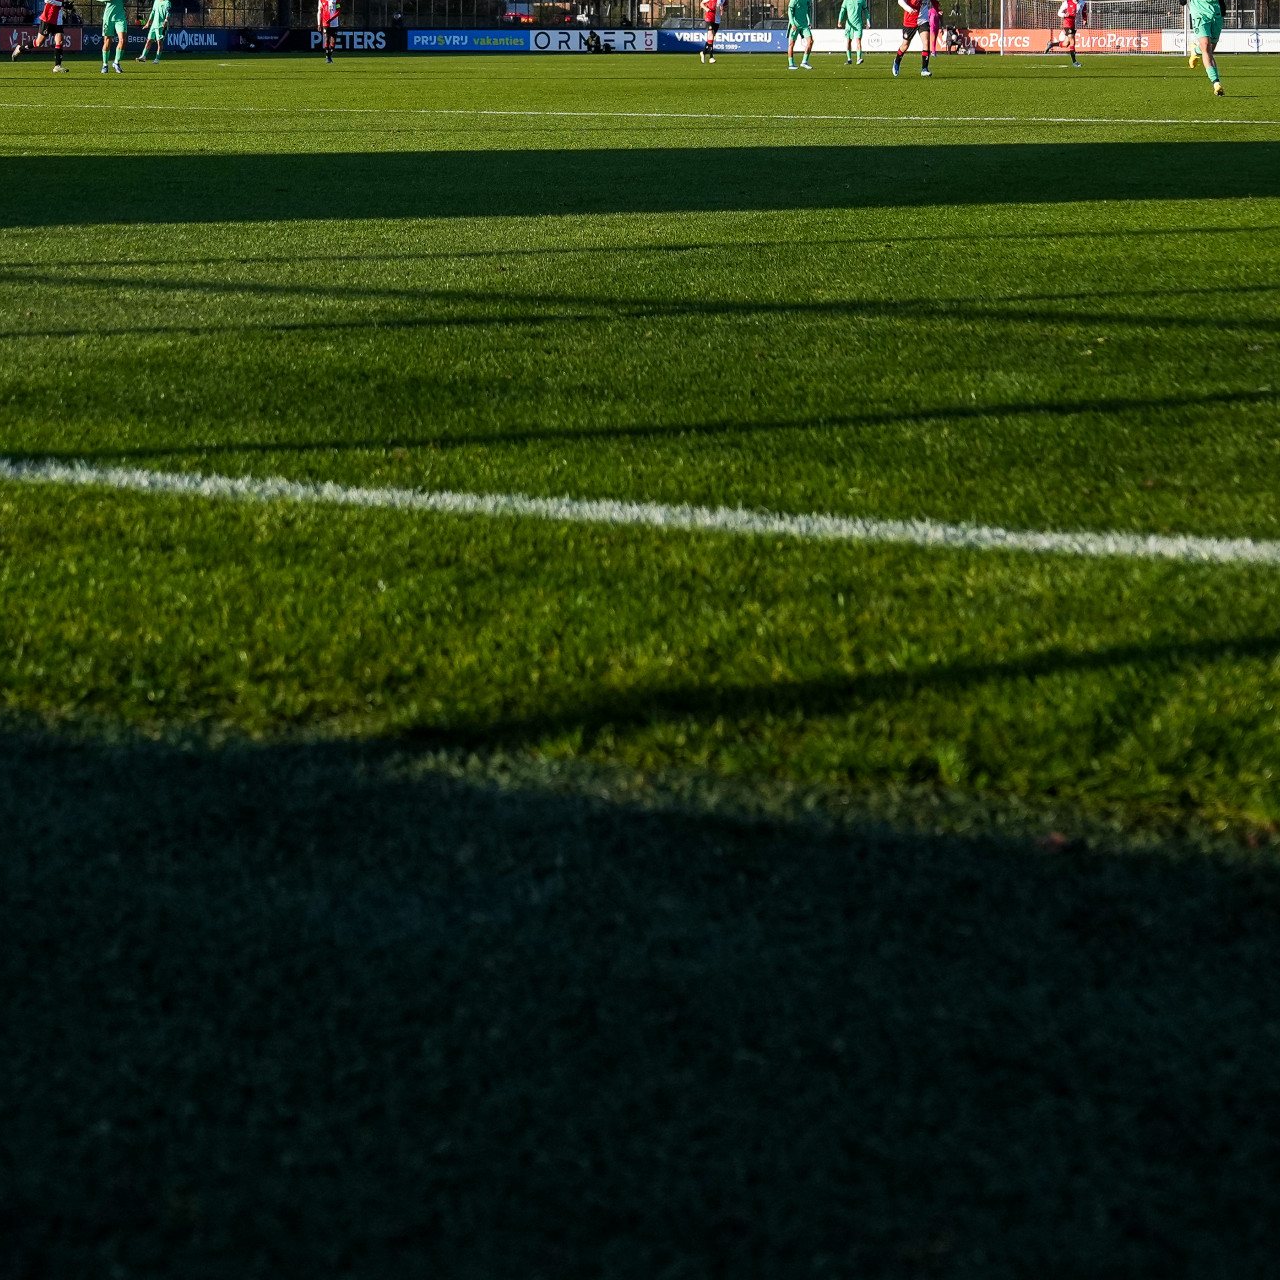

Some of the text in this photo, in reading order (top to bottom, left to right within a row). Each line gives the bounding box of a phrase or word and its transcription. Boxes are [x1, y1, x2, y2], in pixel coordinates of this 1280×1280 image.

[167, 32, 218, 46] KNAKEN.NL
[473, 36, 525, 46] vakanties
[644, 31, 653, 51] ICT
[1074, 33, 1149, 48] EuroParcs
